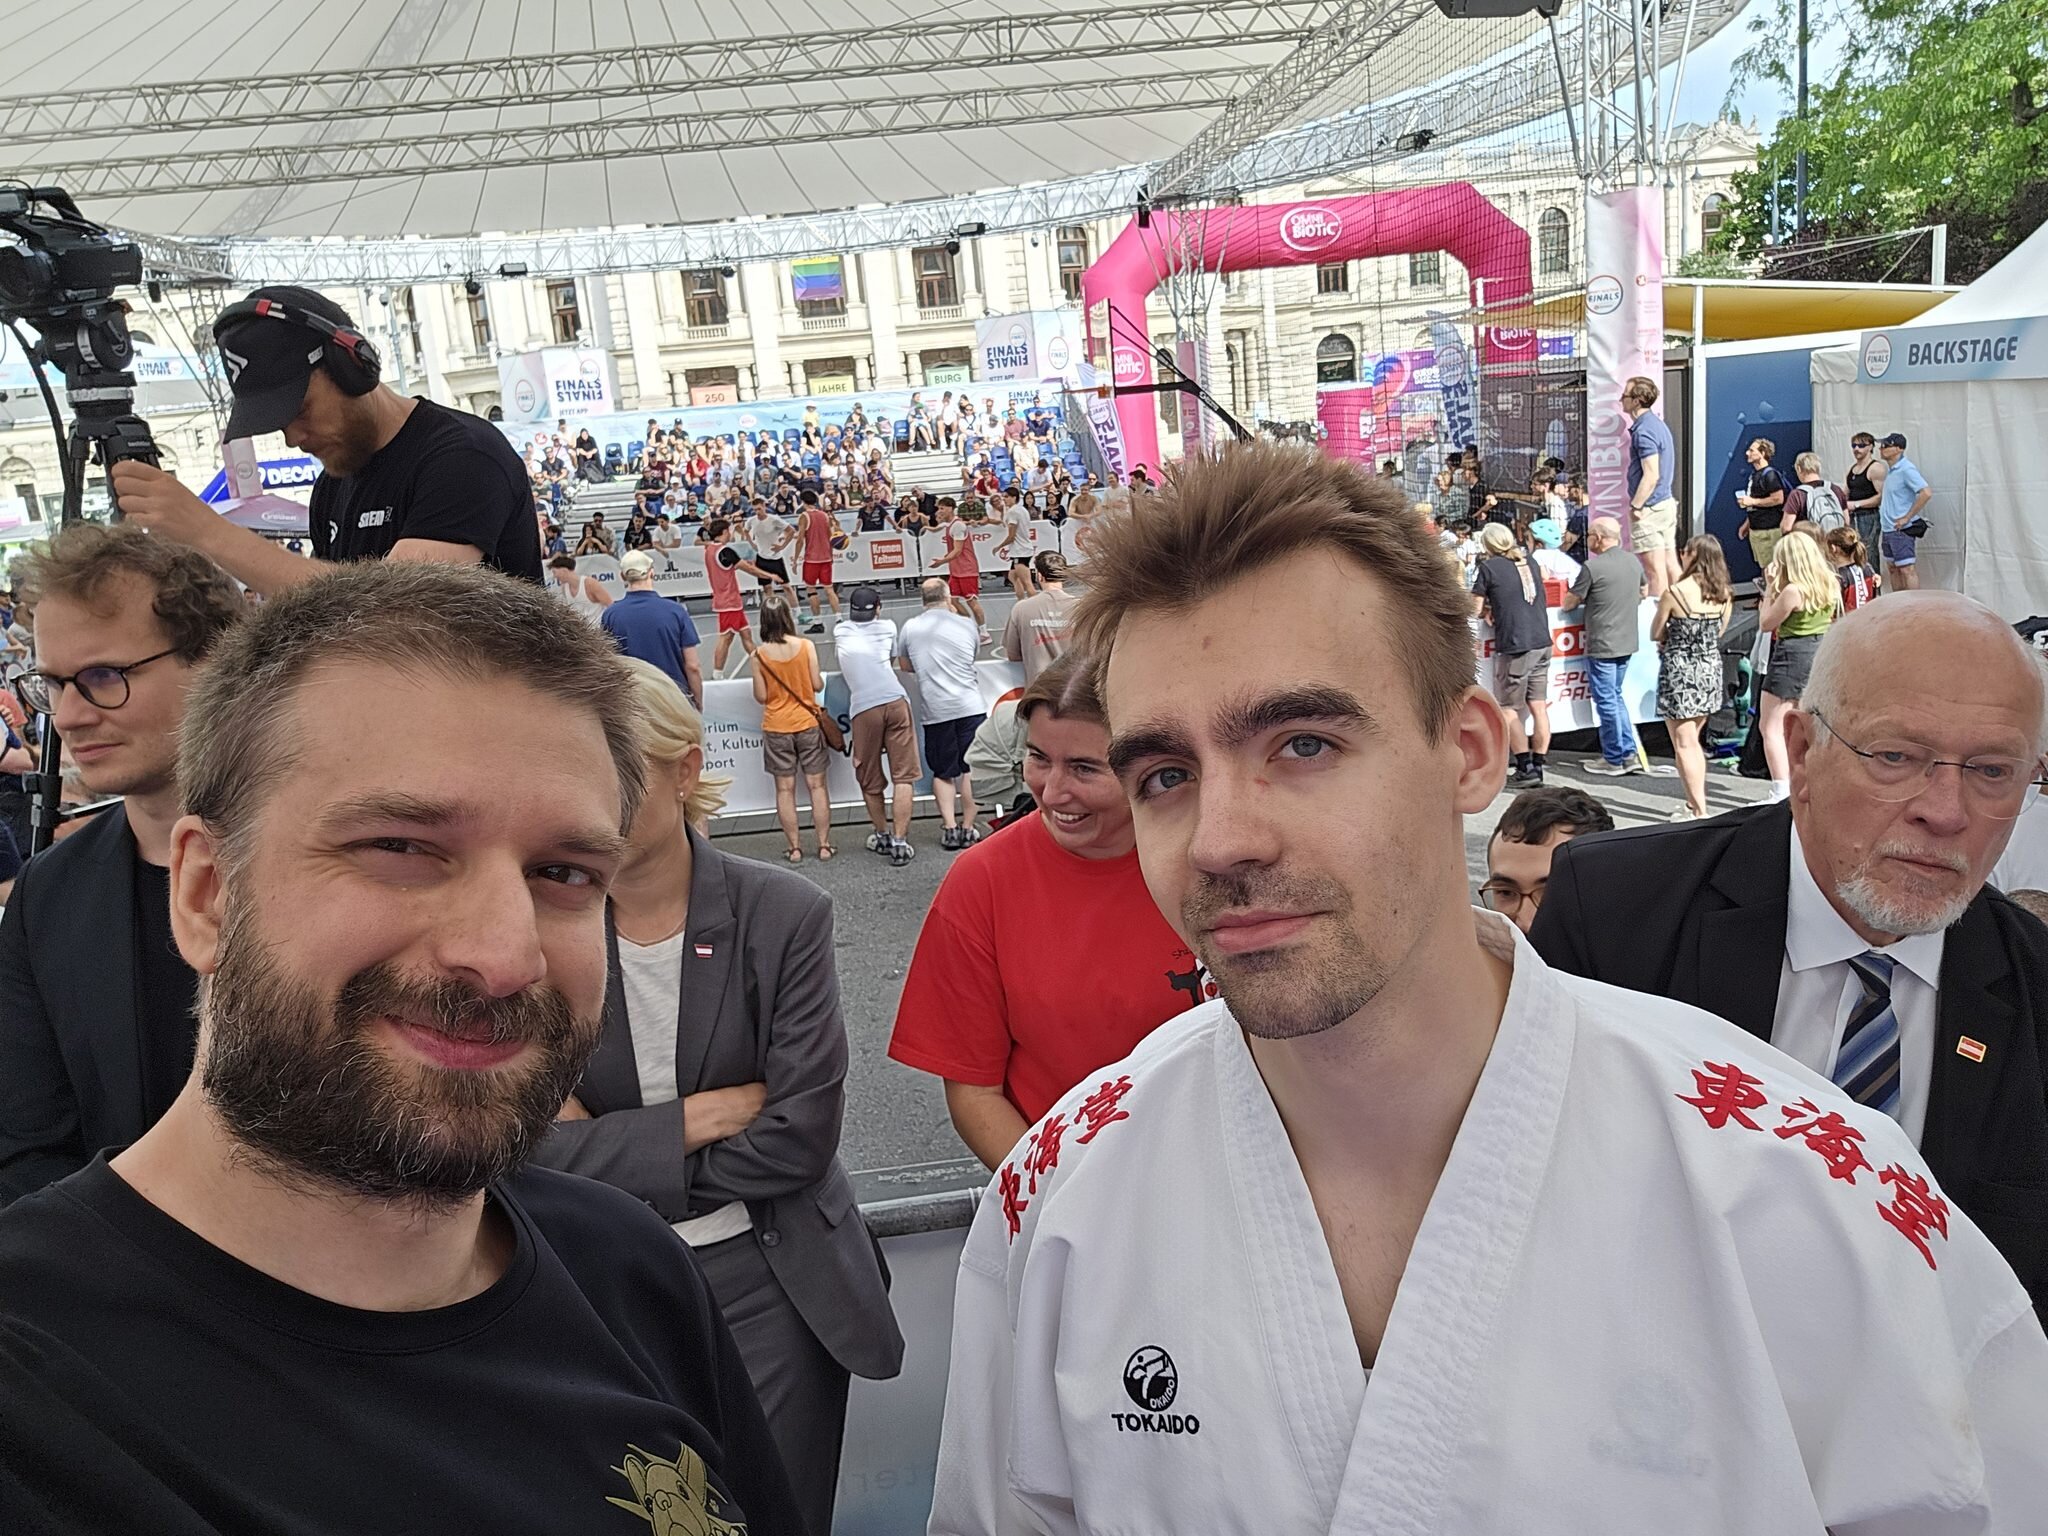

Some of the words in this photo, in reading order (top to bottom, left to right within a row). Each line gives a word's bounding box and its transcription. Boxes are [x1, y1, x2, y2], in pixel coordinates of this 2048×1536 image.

[1588, 292, 1620, 303] FINALS
[986, 342, 1028, 359] FINALS
[1908, 336, 2019, 366] BACKSTAGE
[1867, 355, 1889, 364] FINALS
[556, 378, 602, 391] FINALS
[934, 374, 962, 385] BURG
[817, 383, 848, 394] JAHRE
[705, 393, 725, 404] 250
[673, 571, 703, 581] LEMANS
[1111, 1412, 1200, 1436] TOKAIDO
